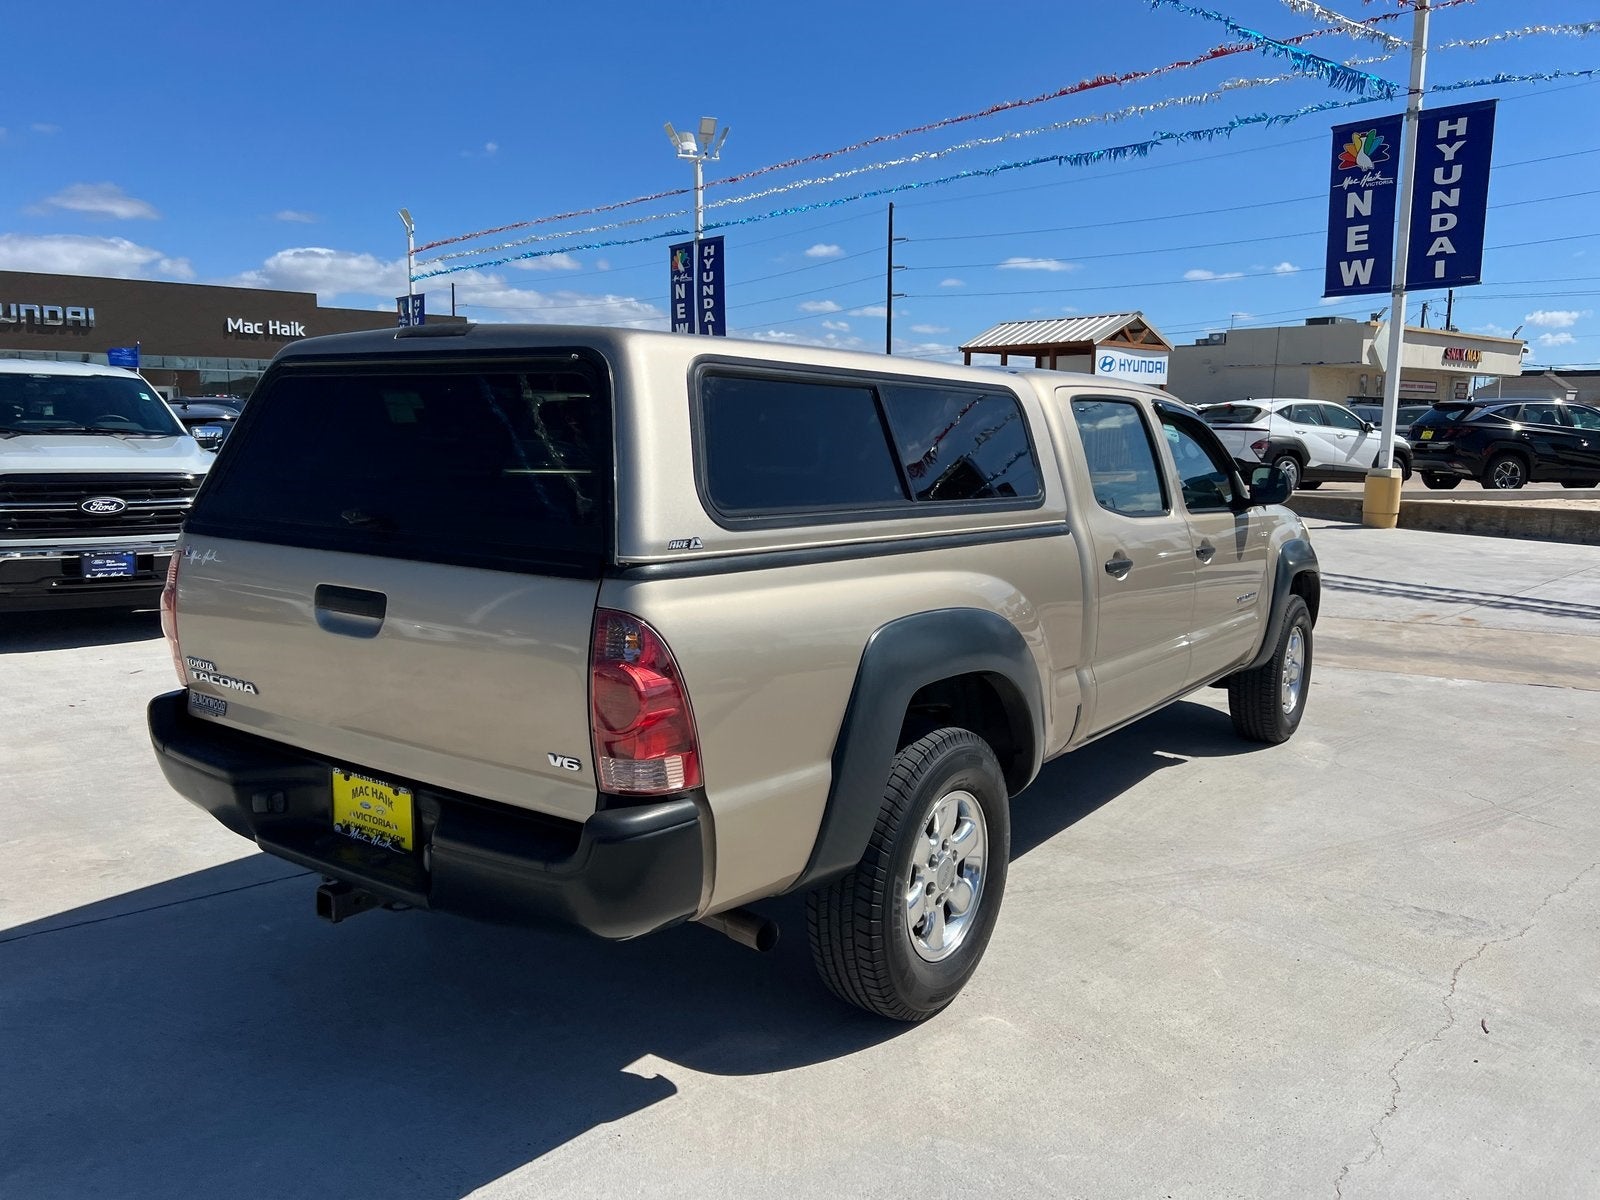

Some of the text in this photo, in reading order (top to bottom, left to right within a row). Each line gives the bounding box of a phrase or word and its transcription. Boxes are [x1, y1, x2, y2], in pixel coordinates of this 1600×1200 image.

[1426, 117, 1468, 279] HYUNDAI
[1340, 190, 1374, 287] NEW
[703, 245, 715, 336] HYUNDAI
[675, 284, 689, 334] NEW
[227, 317, 306, 337] Mac Haik
[1119, 358, 1166, 374] HYUNDAI
[90, 501, 117, 511] Ford
[186, 657, 215, 671] TOYOTA
[191, 670, 257, 695] TACOMA
[547, 753, 580, 771] V6
[351, 786, 394, 809] MAC HAIK
[356, 811, 391, 829] VICTORIA
